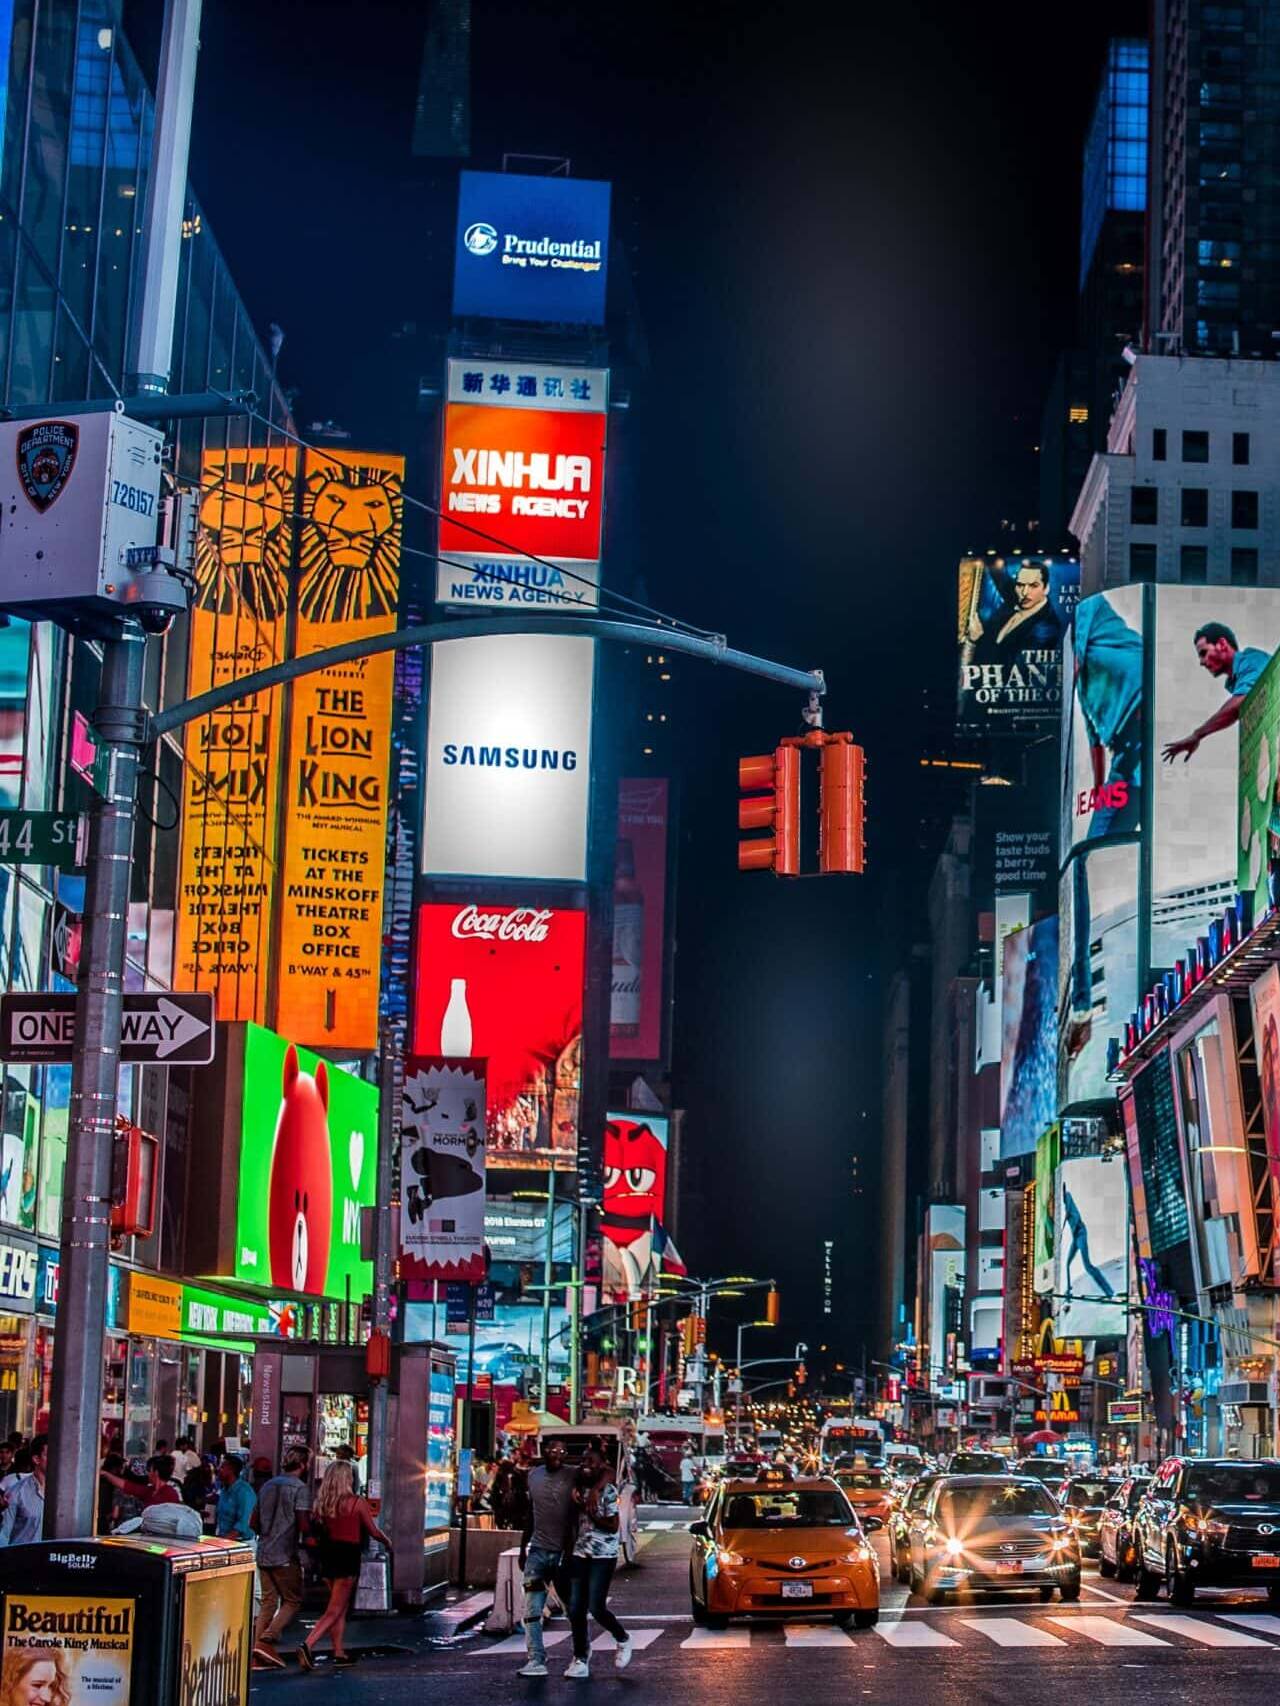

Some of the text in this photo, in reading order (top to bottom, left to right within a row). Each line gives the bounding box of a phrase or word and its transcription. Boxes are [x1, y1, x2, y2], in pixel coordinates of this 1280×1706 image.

[504, 235, 601, 258] Prudential
[463, 372, 591, 400] 新华通讯社
[33, 426, 65, 436] POLICE
[451, 448, 590, 491] XINHUA
[449, 492, 589, 519] NEWS AGENCY
[473, 562, 565, 587] XINHUA
[451, 583, 585, 604] NEWS AGENCY
[316, 688, 364, 712] THE
[975, 689, 1001, 703] OF
[1004, 689, 1043, 702] THE
[306, 716, 372, 755] LION
[443, 744, 577, 771] SAMSUNG
[298, 760, 380, 807] KING
[1076, 780, 1129, 818] JEANS
[51, 820, 76, 844] St
[996, 832, 1050, 843] Show your
[302, 847, 369, 864] TICKETS
[996, 844, 1050, 855] taste buds
[1004, 858, 1036, 870] berry
[305, 867, 364, 882] AT THE
[995, 870, 1047, 883] good time
[288, 885, 380, 902] MINSKOFF
[295, 903, 370, 921] THEATRE
[313, 923, 351, 938] BOX
[302, 943, 360, 958] OFFICE
[333, 967, 342, 977] &
[19, 1015, 184, 1041] ONE WAY
[261, 1364, 273, 1425] Newsstand
[49, 1553, 97, 1565] BigBelly
[8, 1603, 130, 1635] Beautiful
[8, 1635, 129, 1652] The Carole King Musical
